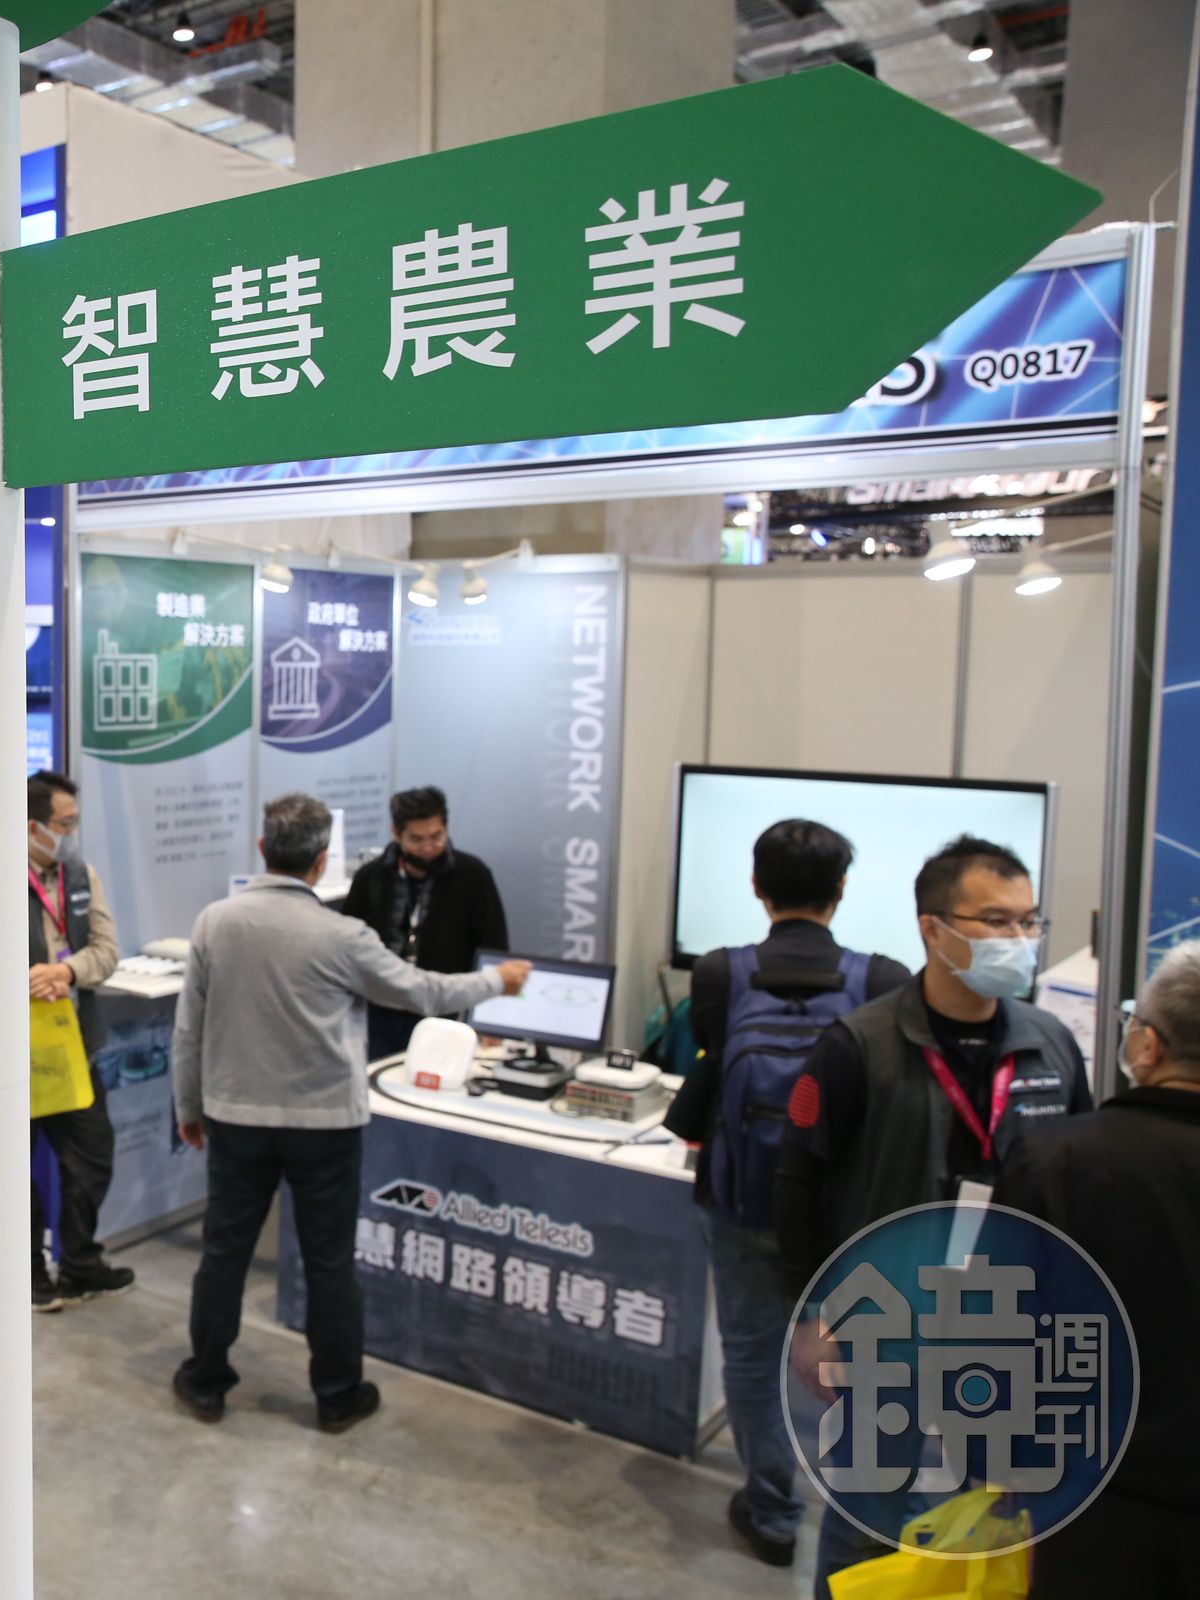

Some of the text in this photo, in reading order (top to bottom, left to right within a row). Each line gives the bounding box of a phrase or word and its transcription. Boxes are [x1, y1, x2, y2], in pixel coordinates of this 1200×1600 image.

[61, 178, 746, 420] 智慧農業
[968, 343, 1091, 389] Q0817
[183, 622, 246, 648] 解決方案
[566, 584, 609, 813] NETWORK
[443, 1194, 593, 1257] Allied Telesis
